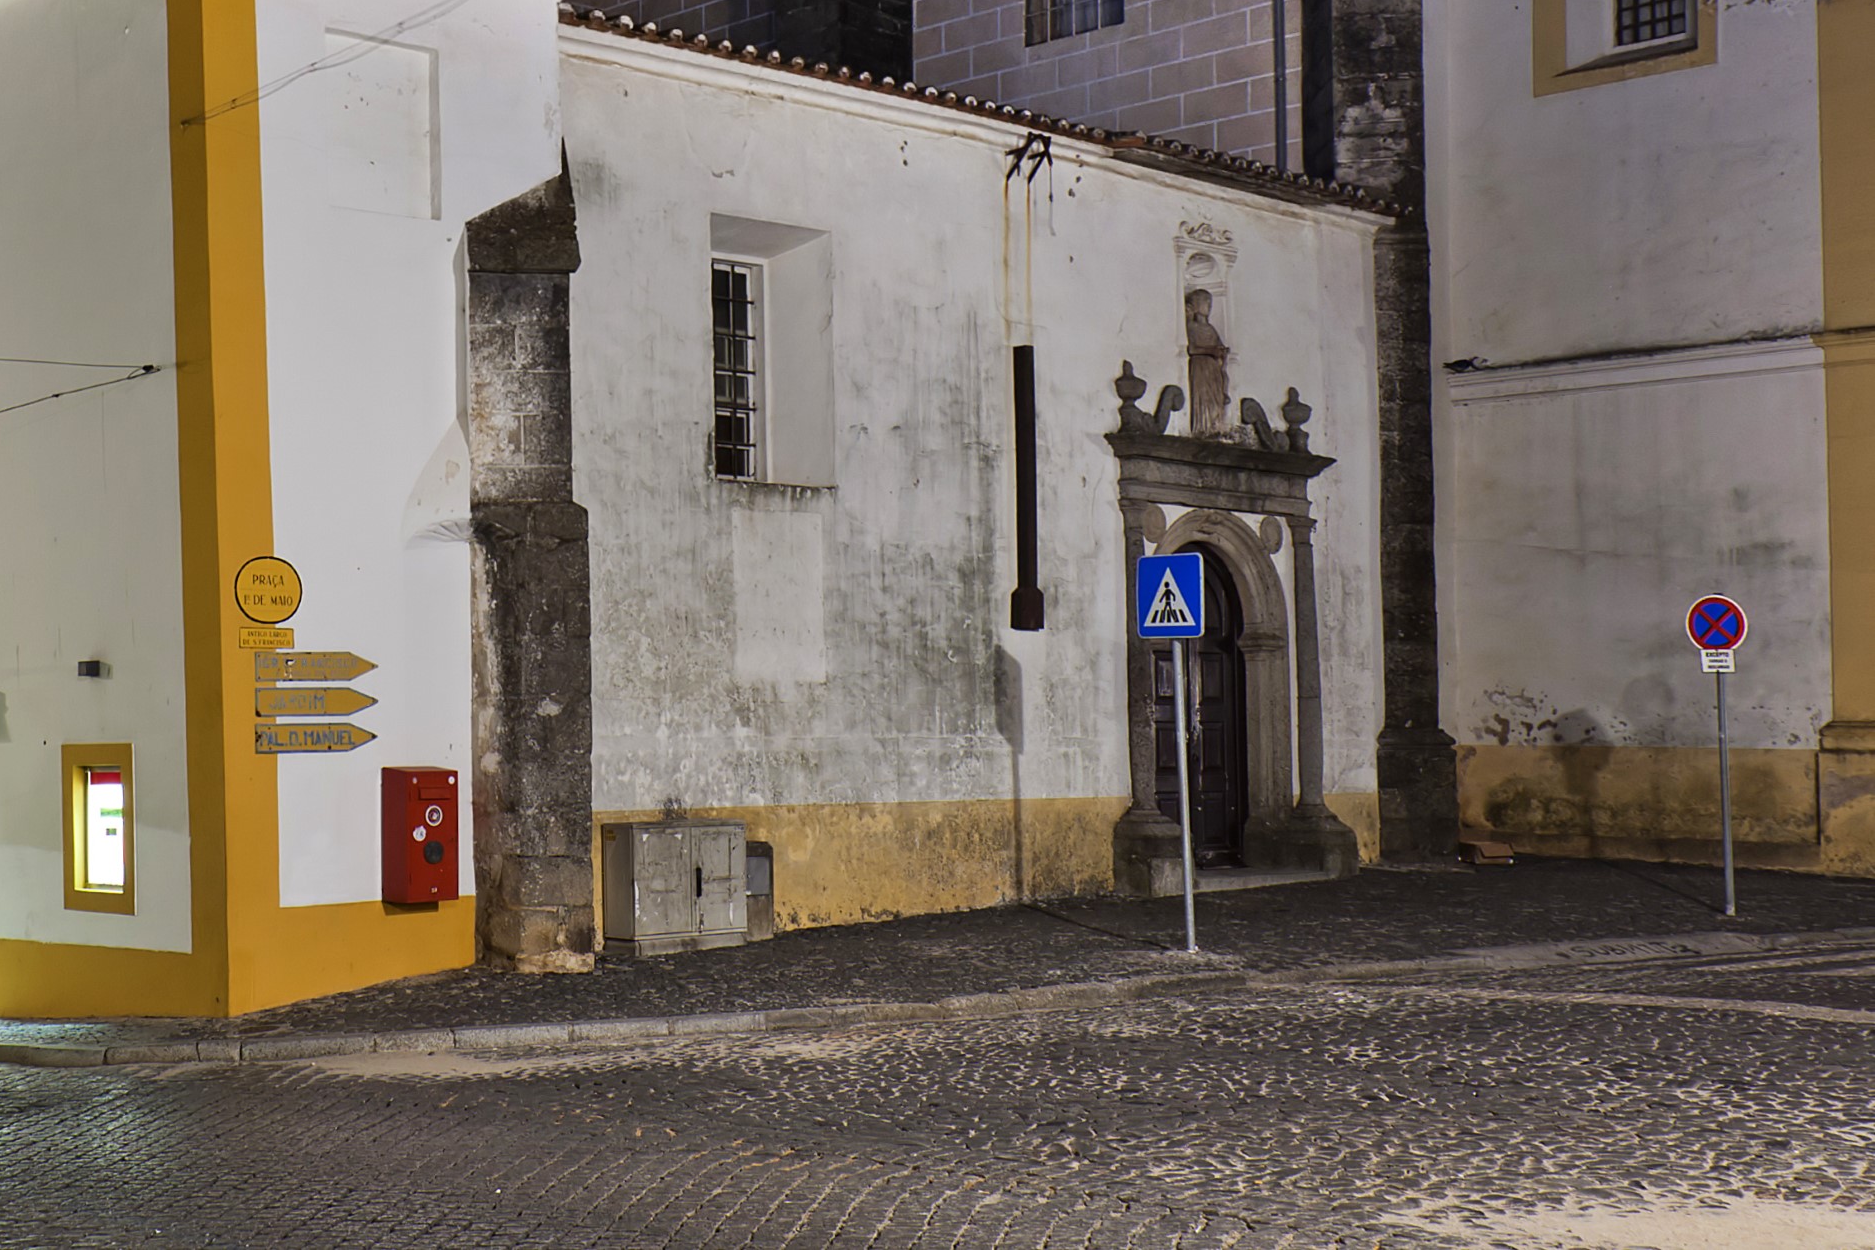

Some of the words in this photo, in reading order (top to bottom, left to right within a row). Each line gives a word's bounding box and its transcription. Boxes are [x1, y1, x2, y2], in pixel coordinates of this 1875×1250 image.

[252, 574, 285, 588] PRAÇA
[253, 595, 266, 606] DE
[270, 595, 294, 607] MAIO
[247, 630, 268, 638] ANTIGO
[268, 694, 325, 710] JARDIM
